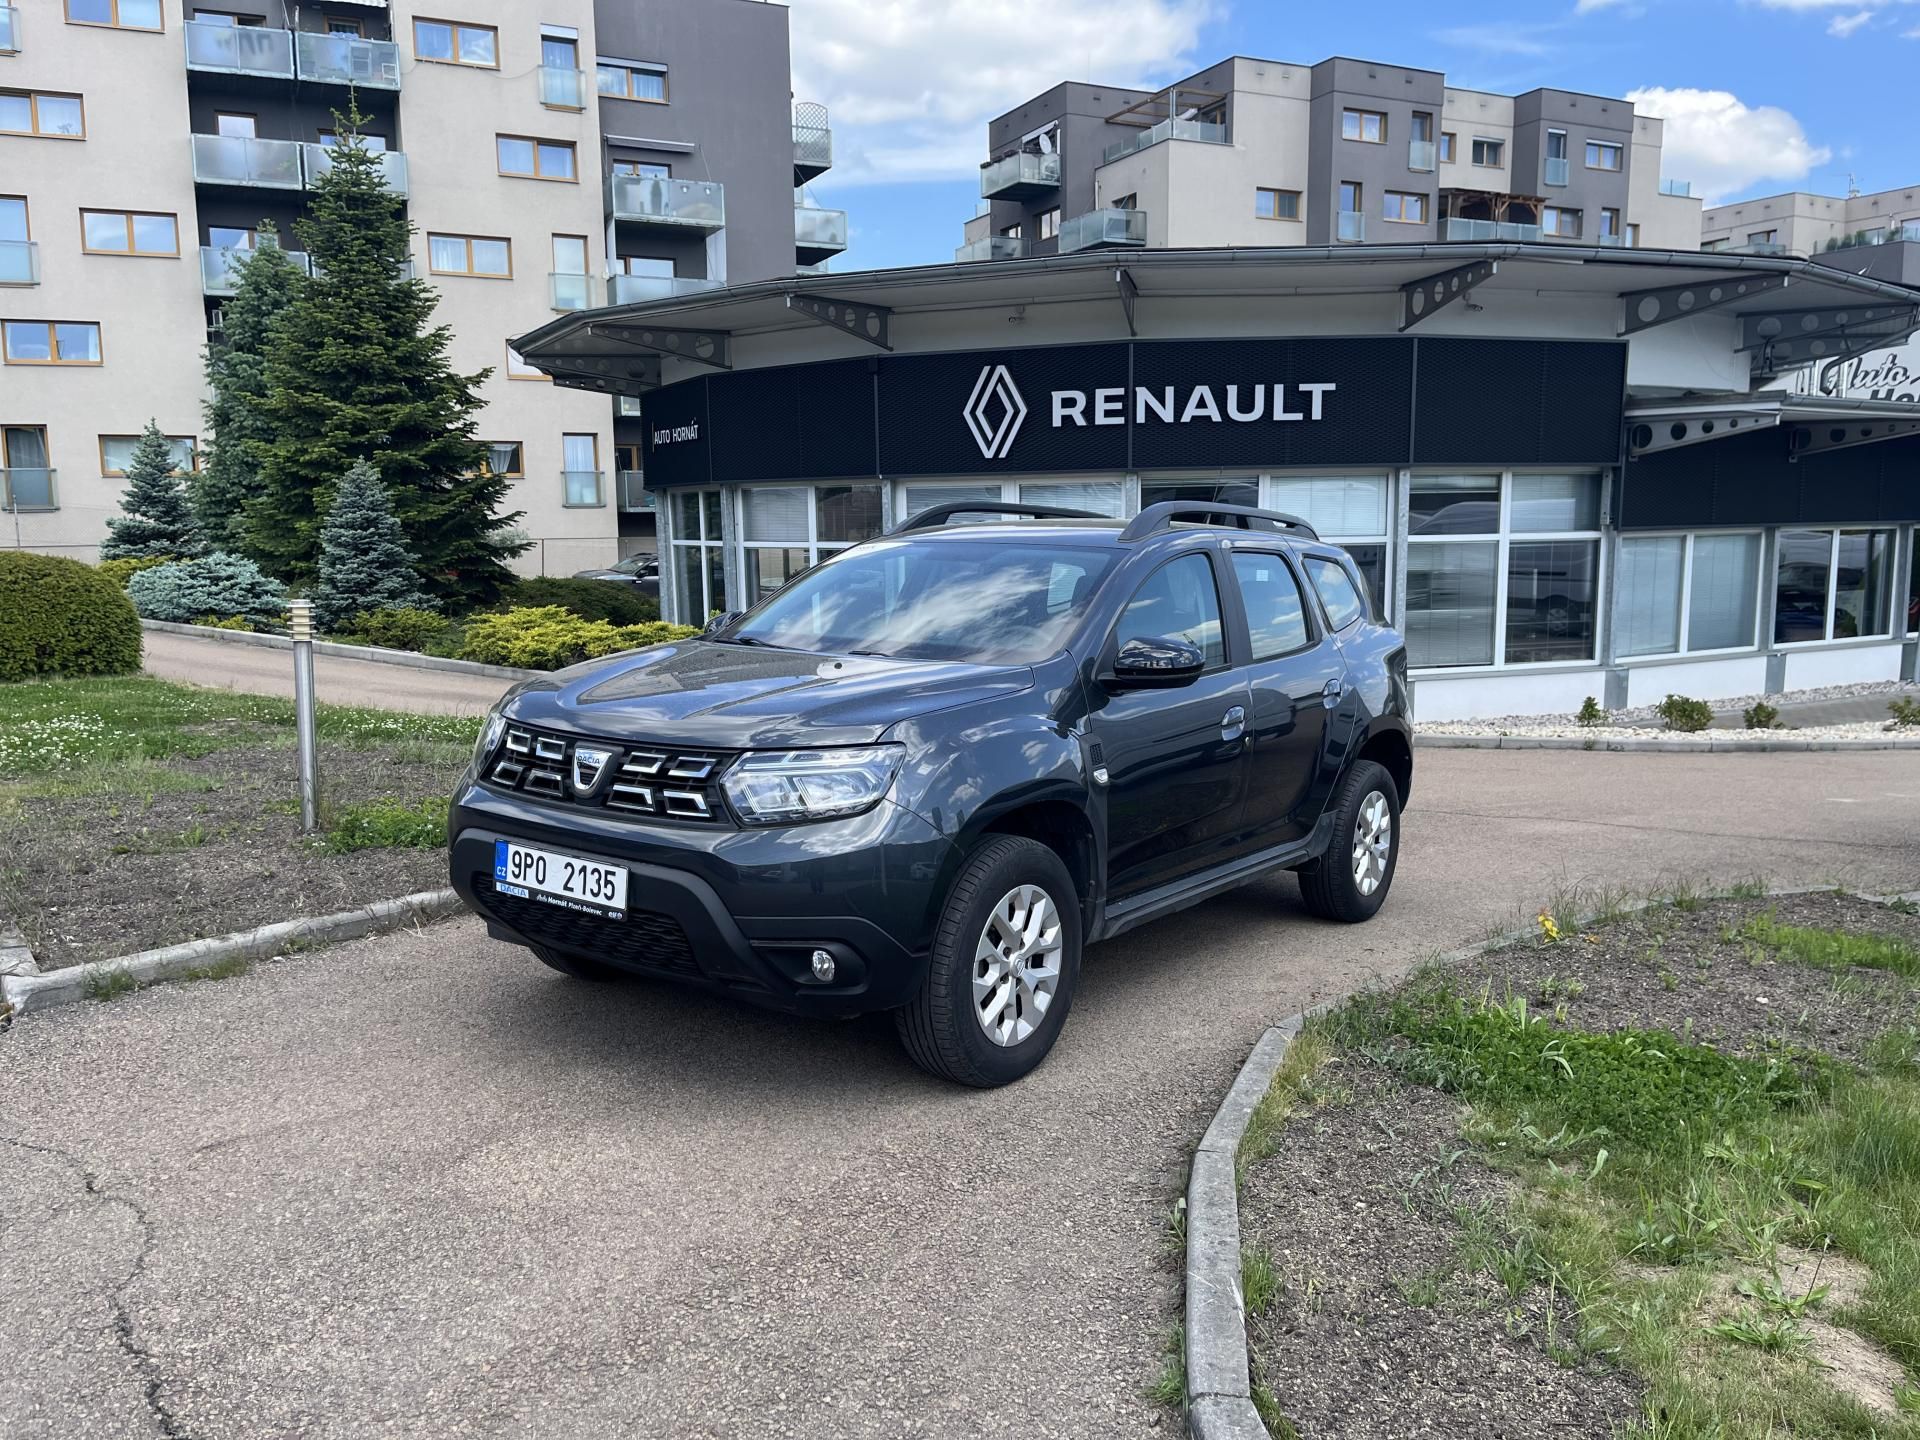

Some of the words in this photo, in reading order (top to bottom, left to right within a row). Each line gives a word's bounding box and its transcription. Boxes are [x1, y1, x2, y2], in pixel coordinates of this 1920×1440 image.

[1051, 382, 1336, 428] RENAULT
[654, 429, 671, 444] AUTO
[672, 420, 698, 442] HORNÁT
[576, 756, 600, 764] DACIA
[496, 866, 506, 876] CZ
[500, 884, 527, 896] DACIA
[563, 862, 616, 901] 2135
